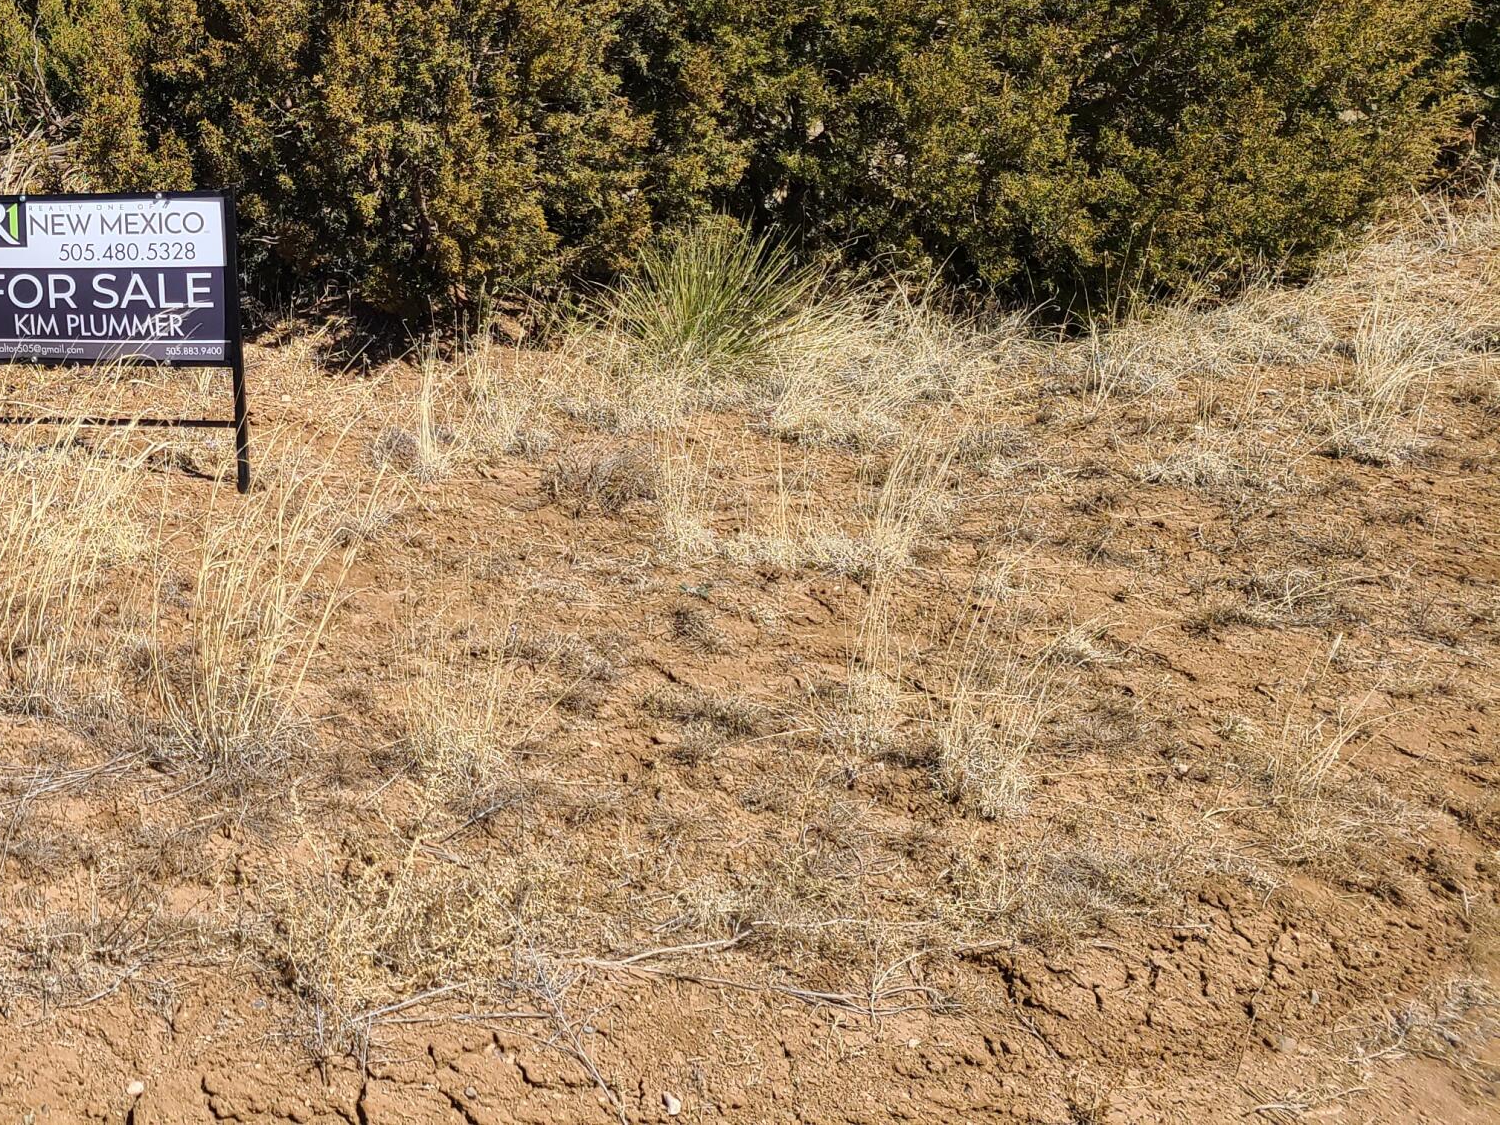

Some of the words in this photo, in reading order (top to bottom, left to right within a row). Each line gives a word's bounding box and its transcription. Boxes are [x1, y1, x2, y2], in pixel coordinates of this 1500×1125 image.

[28, 204, 84, 212] REALTY
[137, 203, 155, 211] OF
[29, 213, 92, 236] NEW
[100, 211, 205, 235] MEXICO
[58, 242, 196, 262] 505.480.5328
[92, 272, 215, 309] SALE
[14, 313, 60, 337] KIM
[67, 313, 185, 337] PLUMMER
[165, 346, 223, 356] 505.883.9400
